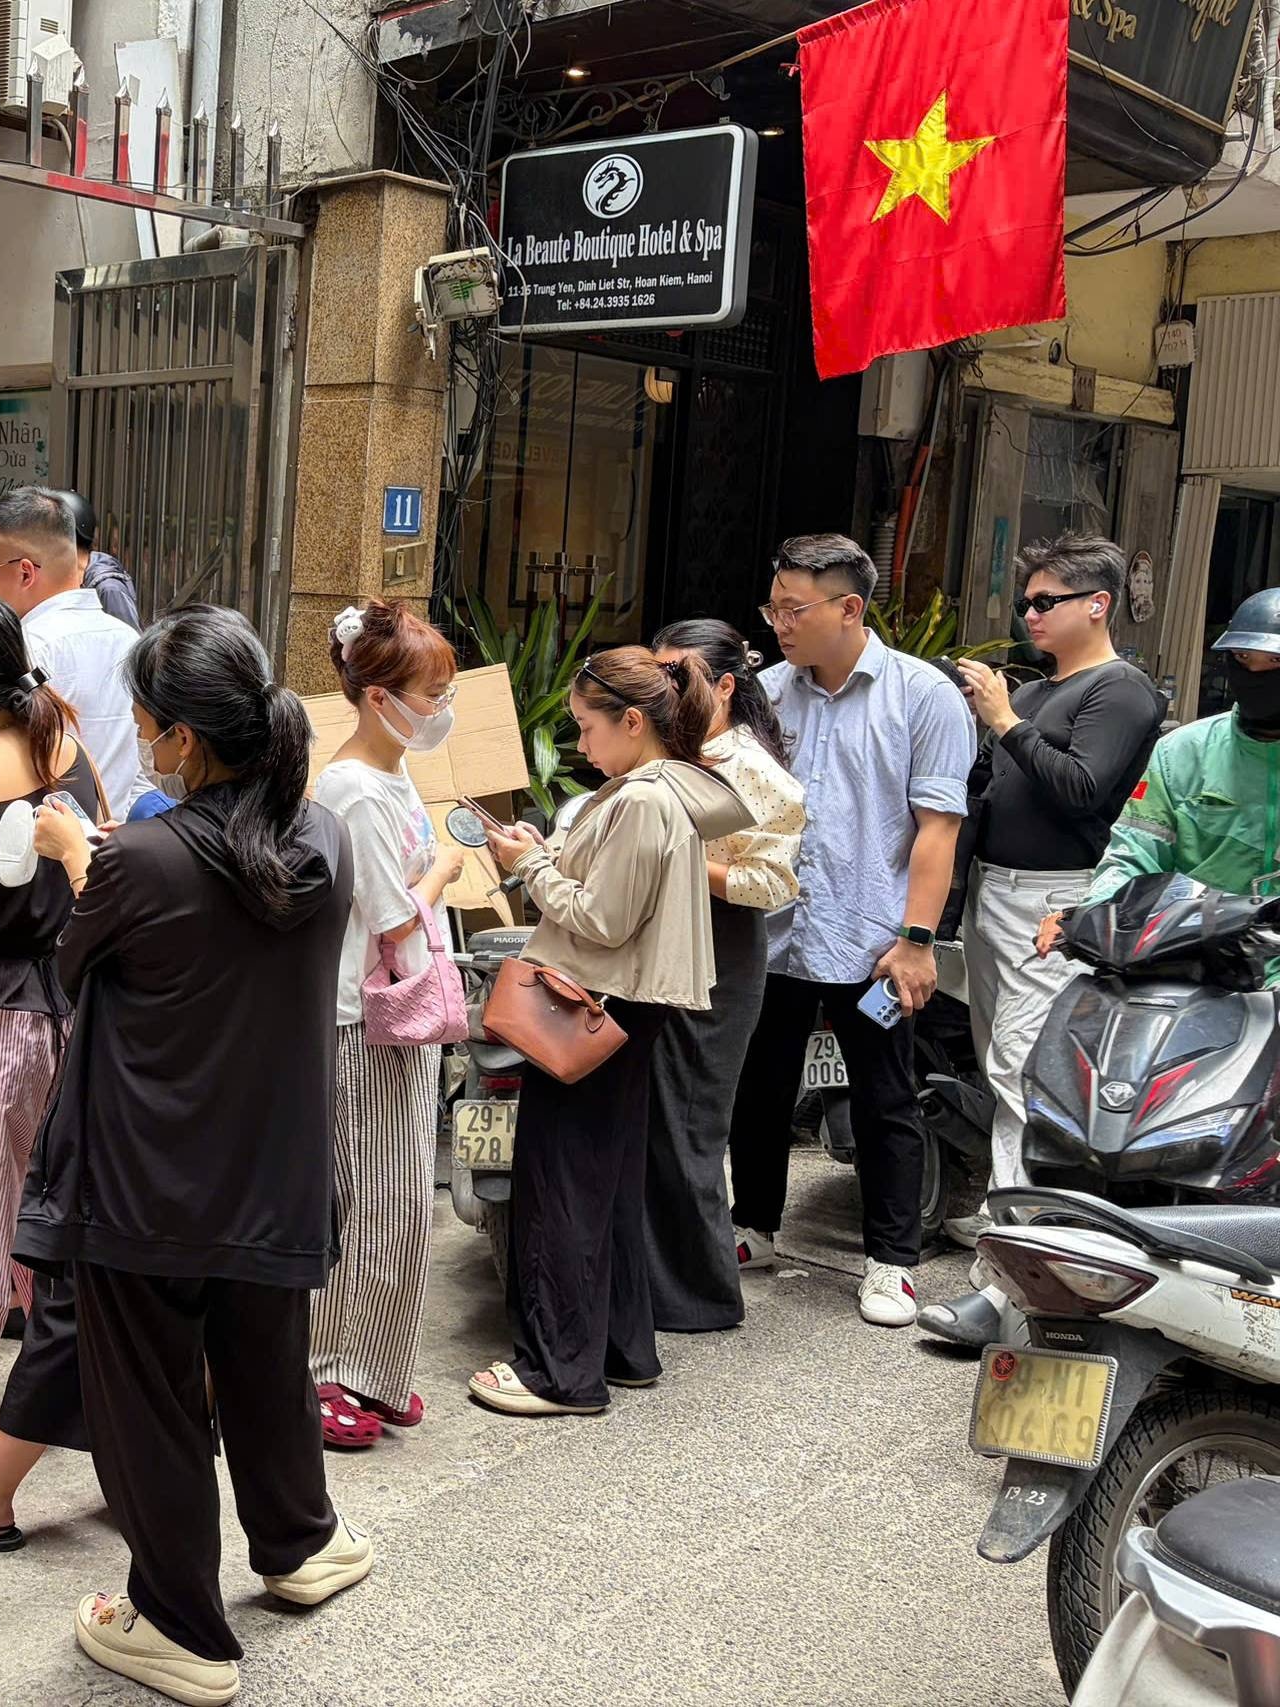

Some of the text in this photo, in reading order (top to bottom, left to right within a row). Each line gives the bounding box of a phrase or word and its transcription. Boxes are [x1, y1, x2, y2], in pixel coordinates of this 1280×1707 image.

[506, 218, 722, 268] La Beaute Boutique Hotel & Spa
[533, 283, 556, 297] Trung
[558, 281, 575, 295] Yen,
[578, 279, 597, 292] Dinh
[598, 278, 615, 291] Liet
[616, 277, 632, 291] Str,
[635, 275, 657, 288] Hoan
[659, 274, 684, 287] Kiem,
[687, 271, 713, 284] Hanoi
[557, 299, 572, 311] Tel:
[632, 293, 655, 306] 1626
[393, 494, 412, 526] 11
[807, 1061, 845, 1086] 006
[1045, 1331, 1084, 1342] HONDA
